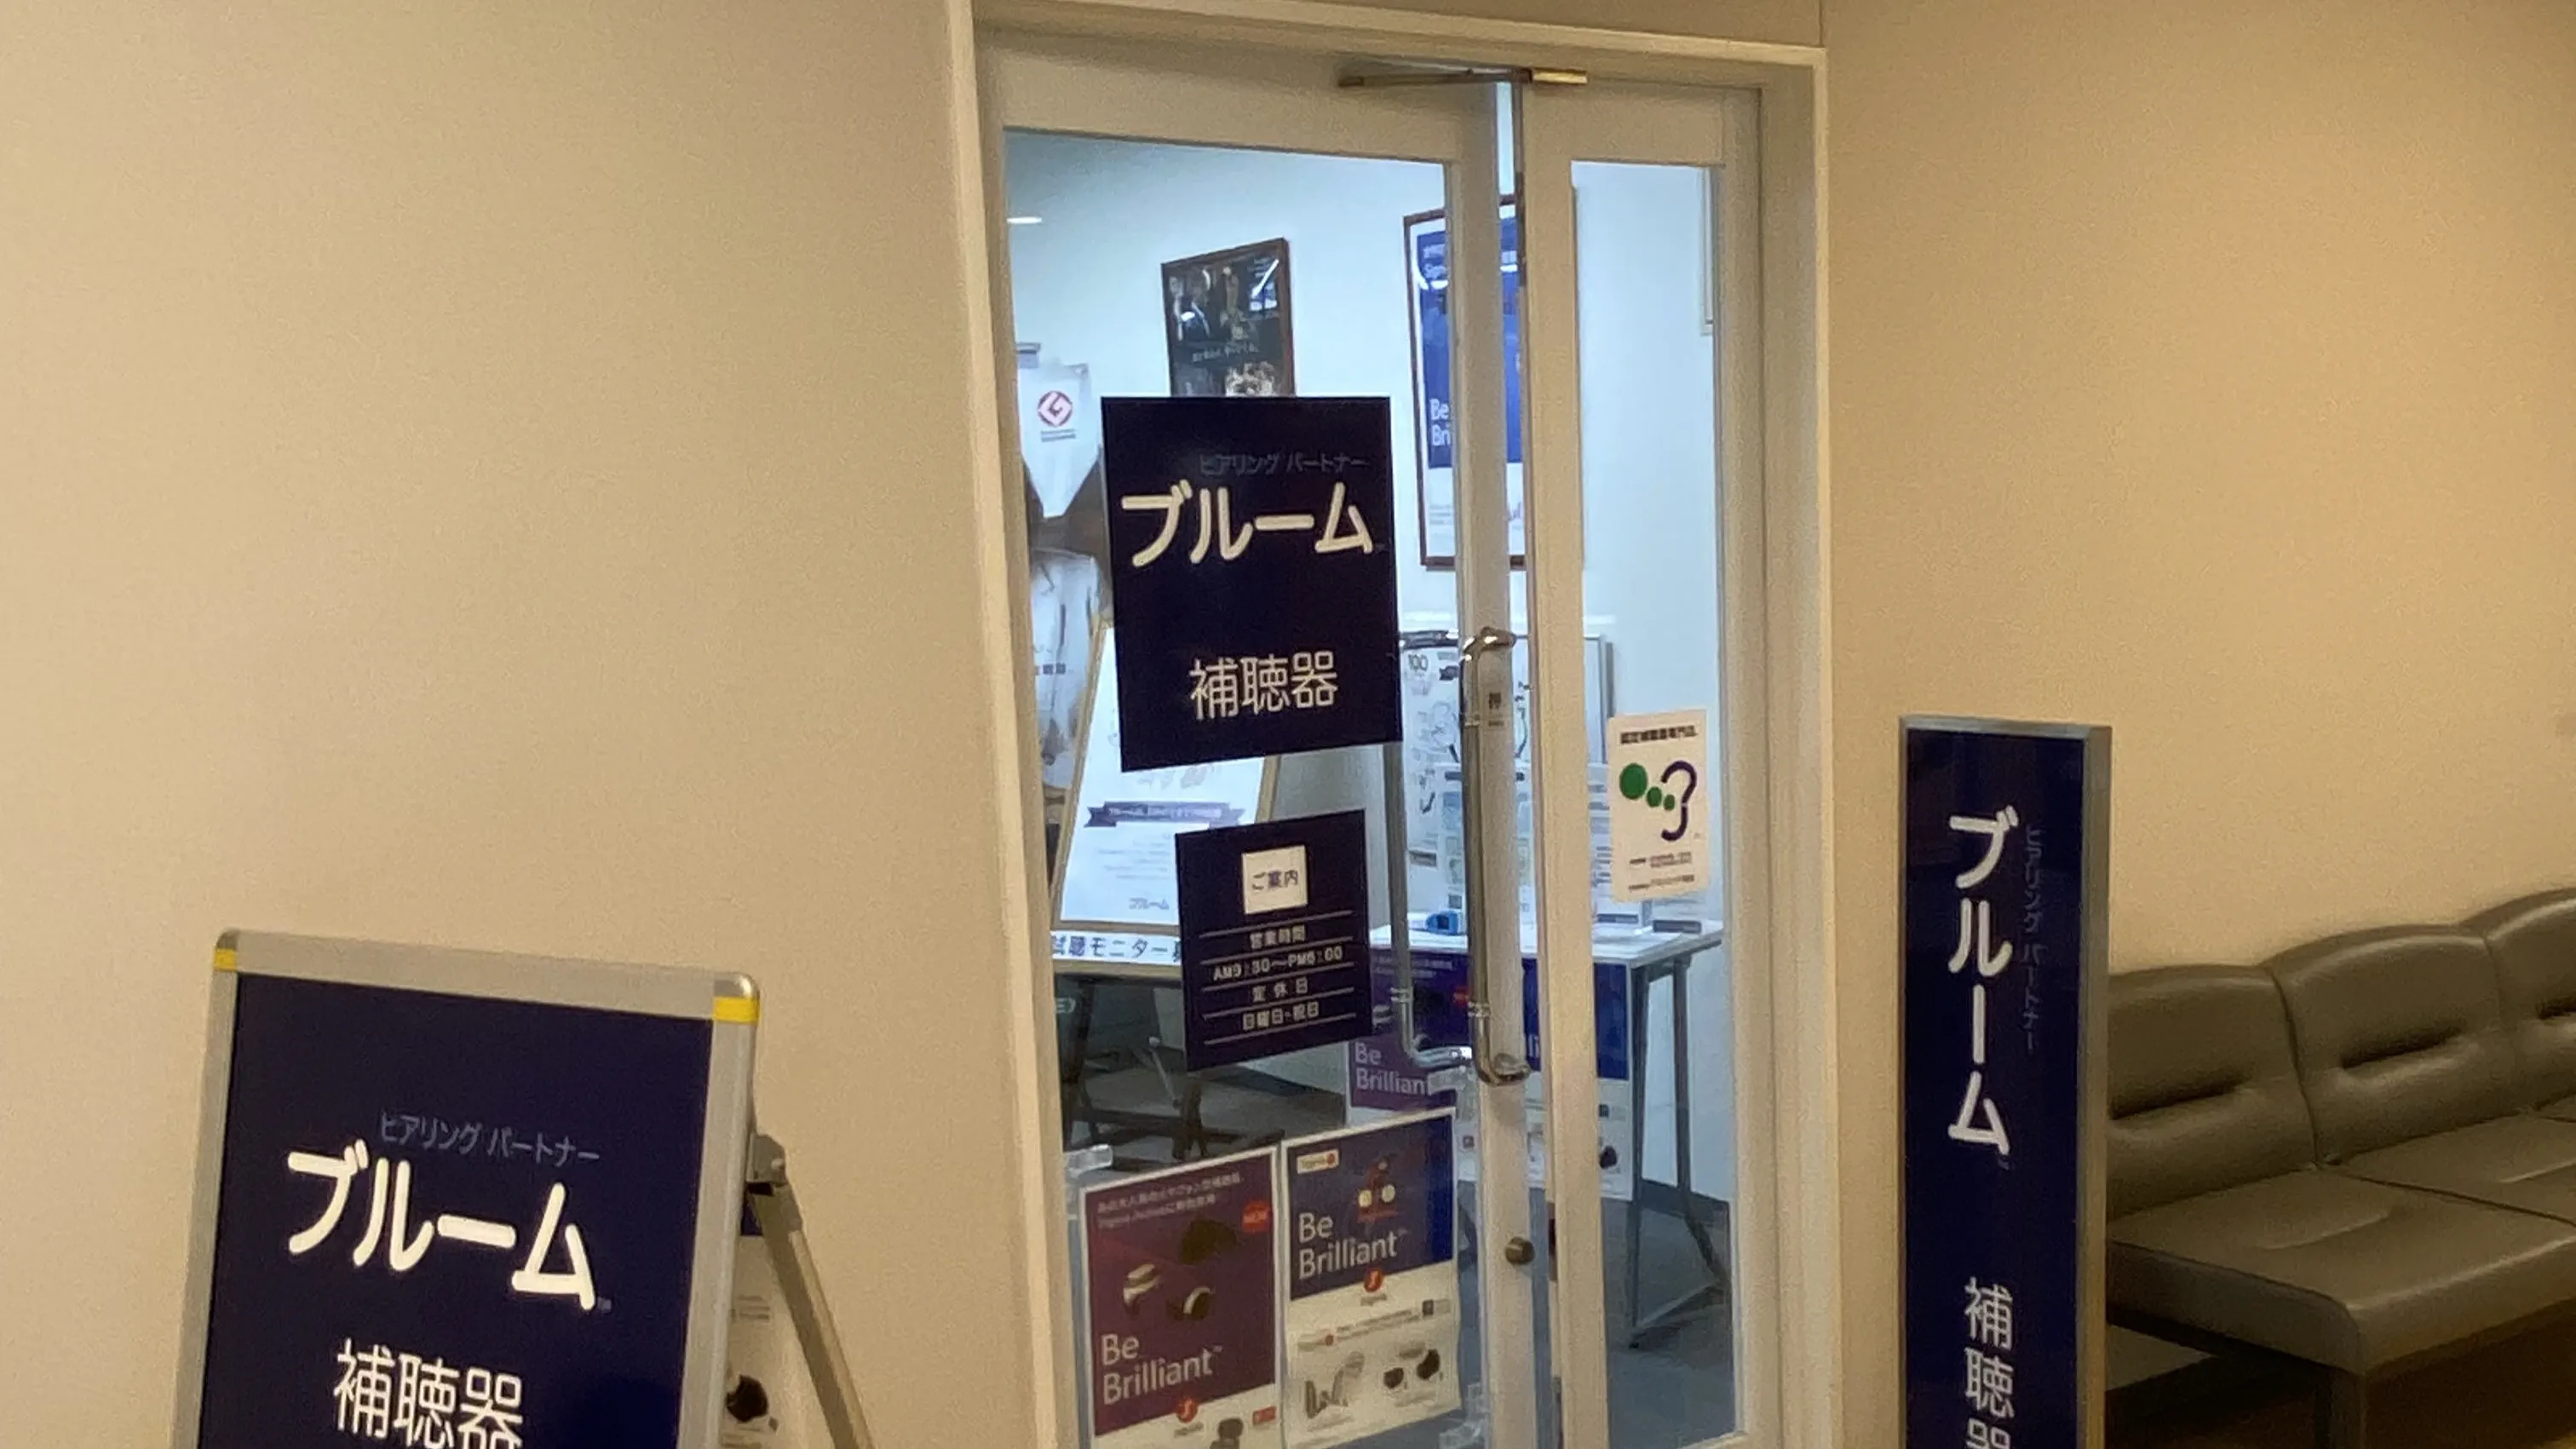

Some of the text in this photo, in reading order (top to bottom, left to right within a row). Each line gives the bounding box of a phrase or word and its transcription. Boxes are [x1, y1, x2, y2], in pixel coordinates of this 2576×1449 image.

[1199, 451, 1371, 475] ヒアリング パートナー
[1121, 479, 1373, 568] ブルーム
[1188, 651, 1338, 721] 補聴器
[1251, 869, 1299, 892] ご案内
[1250, 924, 1306, 949] 営業時間
[2022, 825, 2047, 1051] ヒアリング パートナー
[1947, 805, 2019, 1155] ブルーム
[1354, 1041, 1382, 1064] Be
[382, 1112, 601, 1167] ヒアリング パートナー
[288, 1138, 596, 1311] ブルーム
[1298, 1212, 1334, 1243] Be
[1298, 1231, 1398, 1279] Brilliant
[1101, 1334, 1140, 1366] Be
[1103, 1348, 1213, 1406] Brilliant
[333, 1337, 524, 1449] 補聴器
